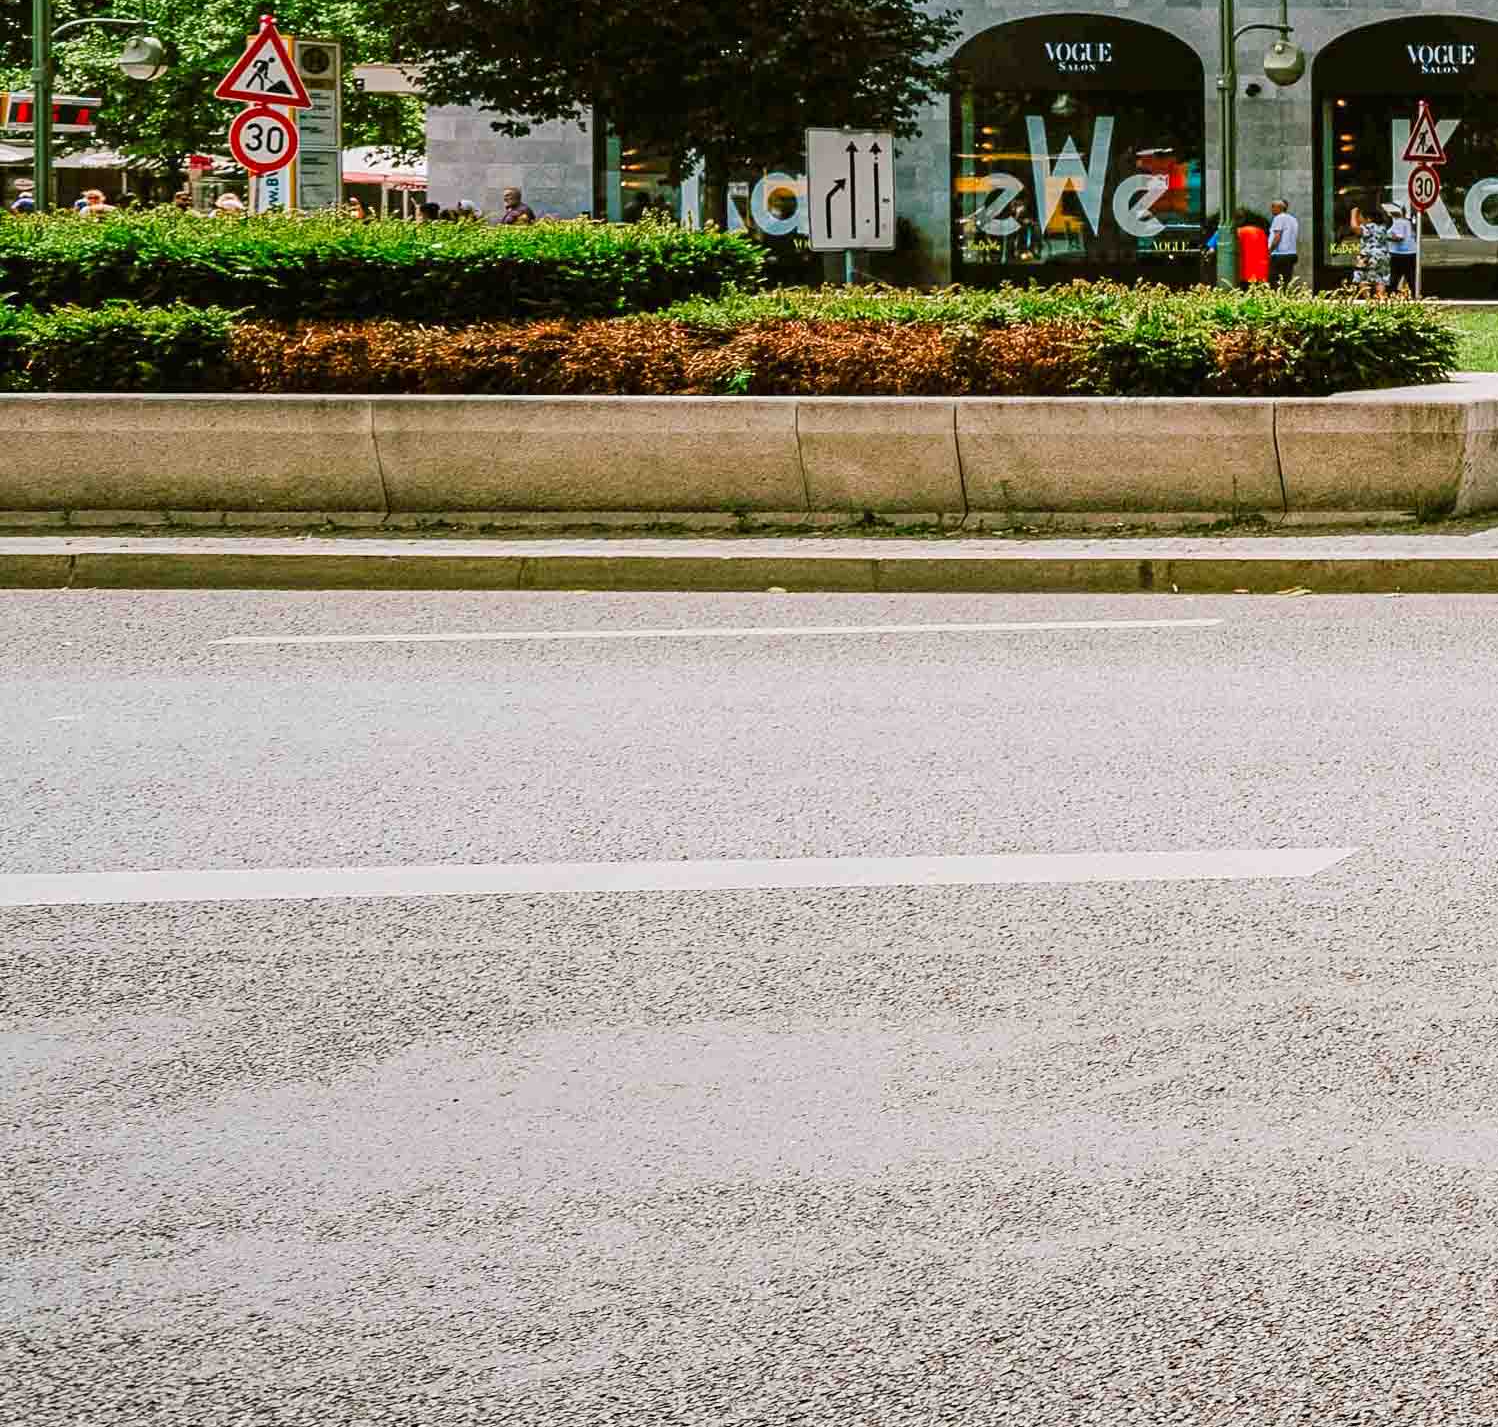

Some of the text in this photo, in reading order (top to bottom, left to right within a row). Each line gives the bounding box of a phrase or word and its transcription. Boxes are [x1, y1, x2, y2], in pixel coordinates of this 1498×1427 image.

[1044, 42, 1113, 62] VOGUE
[1407, 45, 1475, 65] VOGUE
[1057, 62, 1097, 72] SALON
[1421, 65, 1459, 74] SALON
[245, 123, 284, 154] 30
[1415, 177, 1434, 199] 30
[1151, 240, 1191, 252] VOGUE
